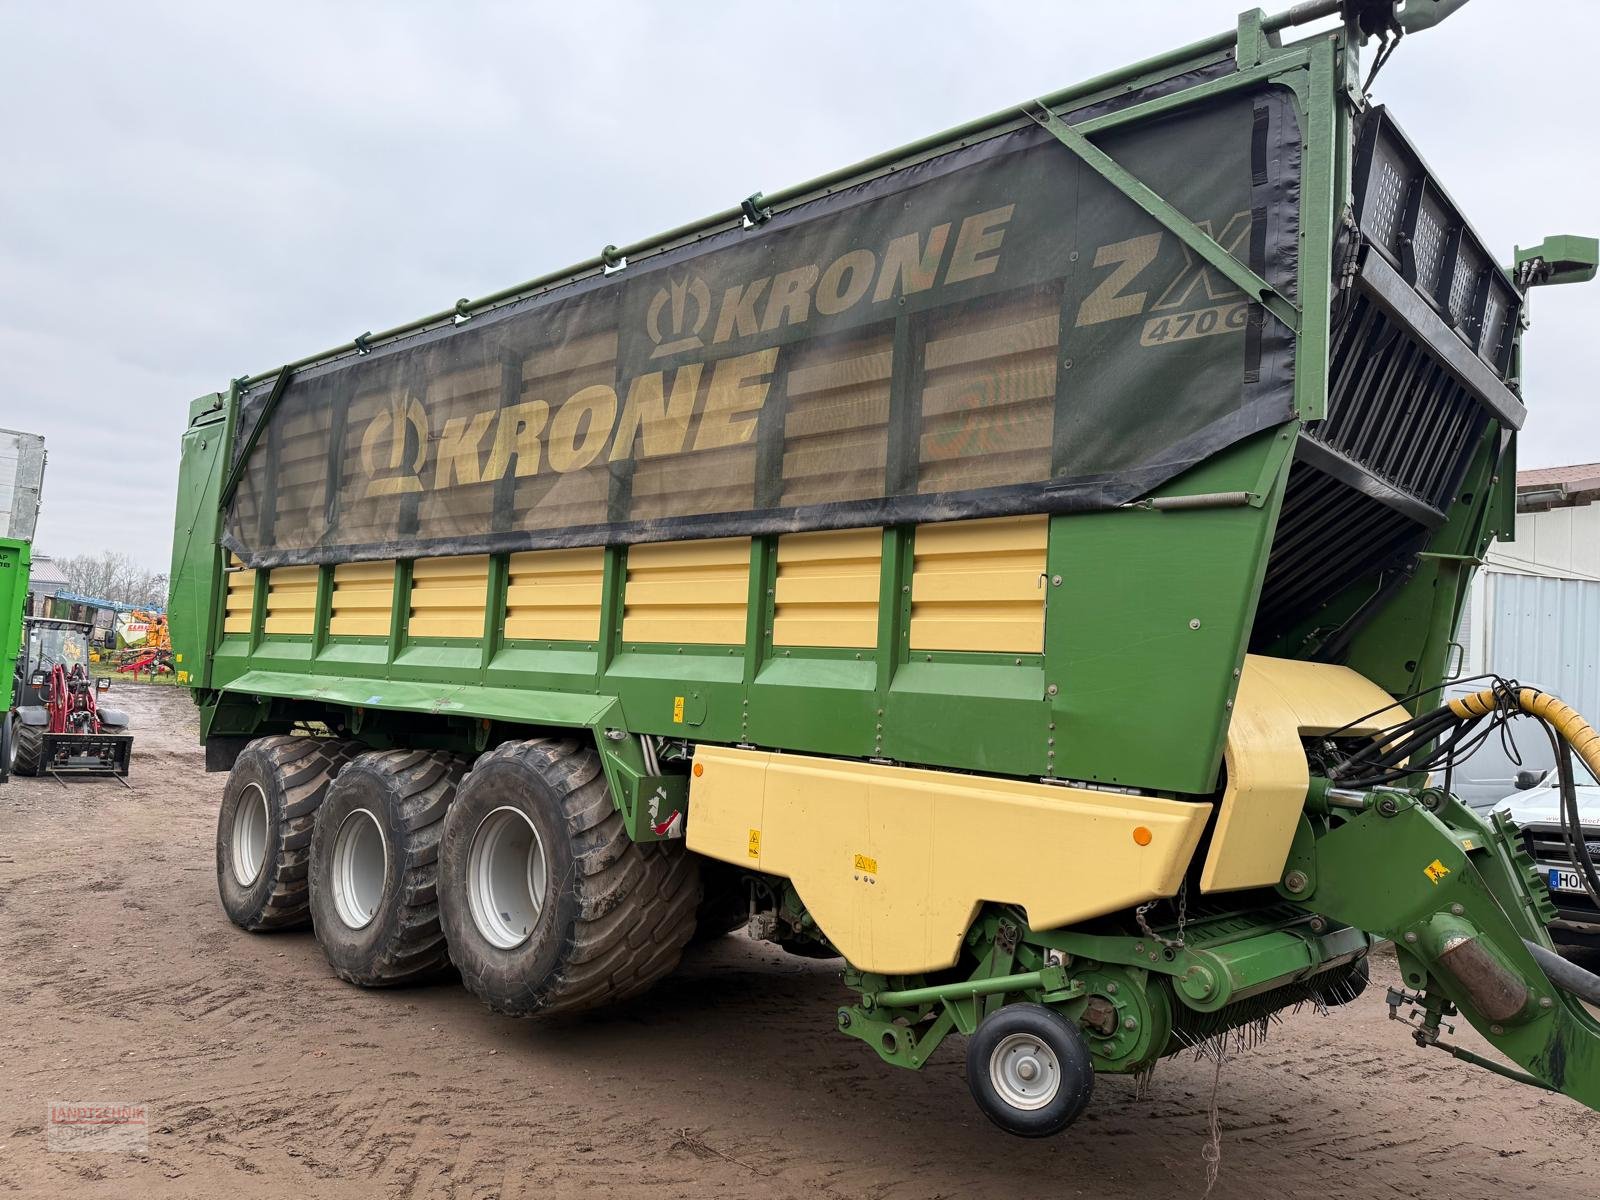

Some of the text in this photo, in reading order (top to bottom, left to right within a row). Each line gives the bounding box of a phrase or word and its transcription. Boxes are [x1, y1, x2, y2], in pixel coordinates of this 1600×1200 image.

[713, 203, 1015, 344] KRONE
[1147, 310, 1218, 342] 470
[434, 347, 779, 490] KRONE
